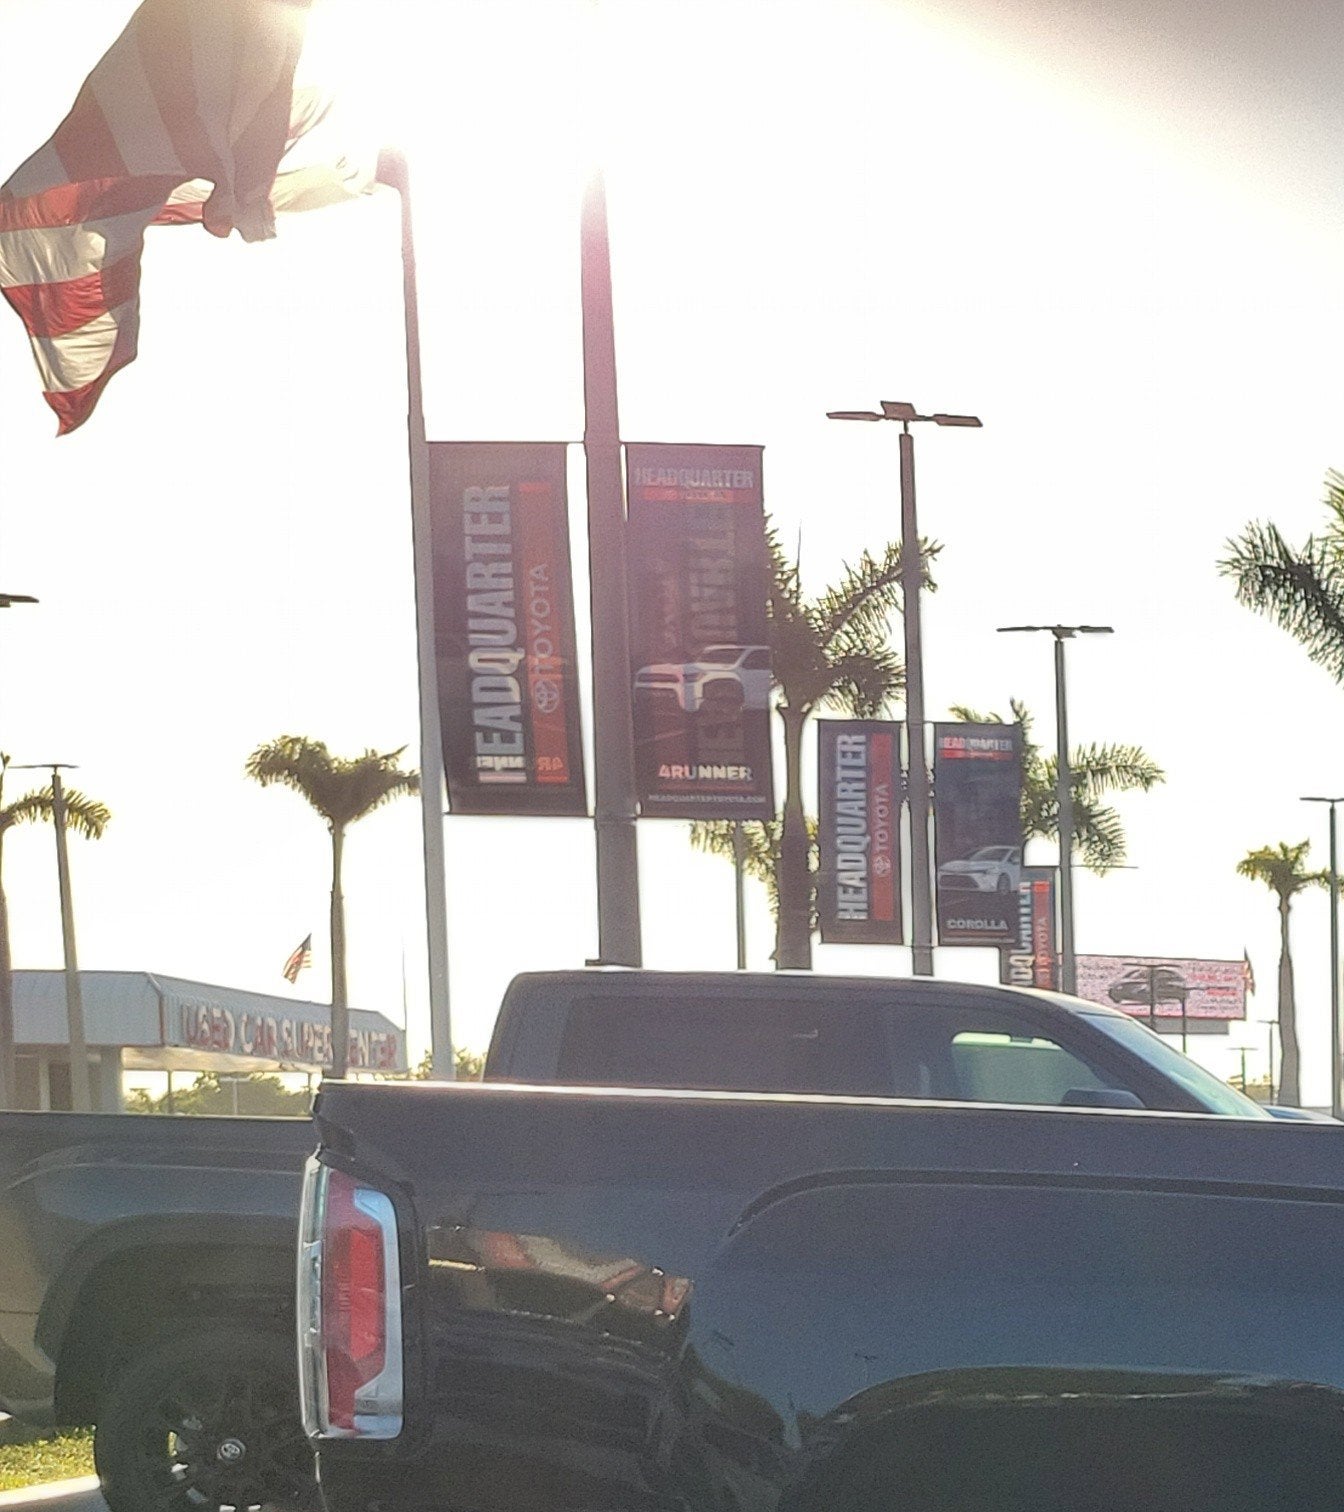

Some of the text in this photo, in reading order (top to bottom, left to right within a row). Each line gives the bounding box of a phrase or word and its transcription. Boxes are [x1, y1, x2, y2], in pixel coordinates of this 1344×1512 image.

[463, 485, 526, 783] HEADQUARTER
[529, 563, 555, 672] TOYOTA
[658, 764, 754, 780] 4RUNNER
[837, 734, 871, 919] HEADQUARTER
[875, 784, 889, 853] TOYOTA
[947, 918, 1008, 930] COROLLA
[182, 1004, 235, 1050] USED
[240, 1010, 278, 1057] CAR
[347, 1028, 397, 1069] ENTER
